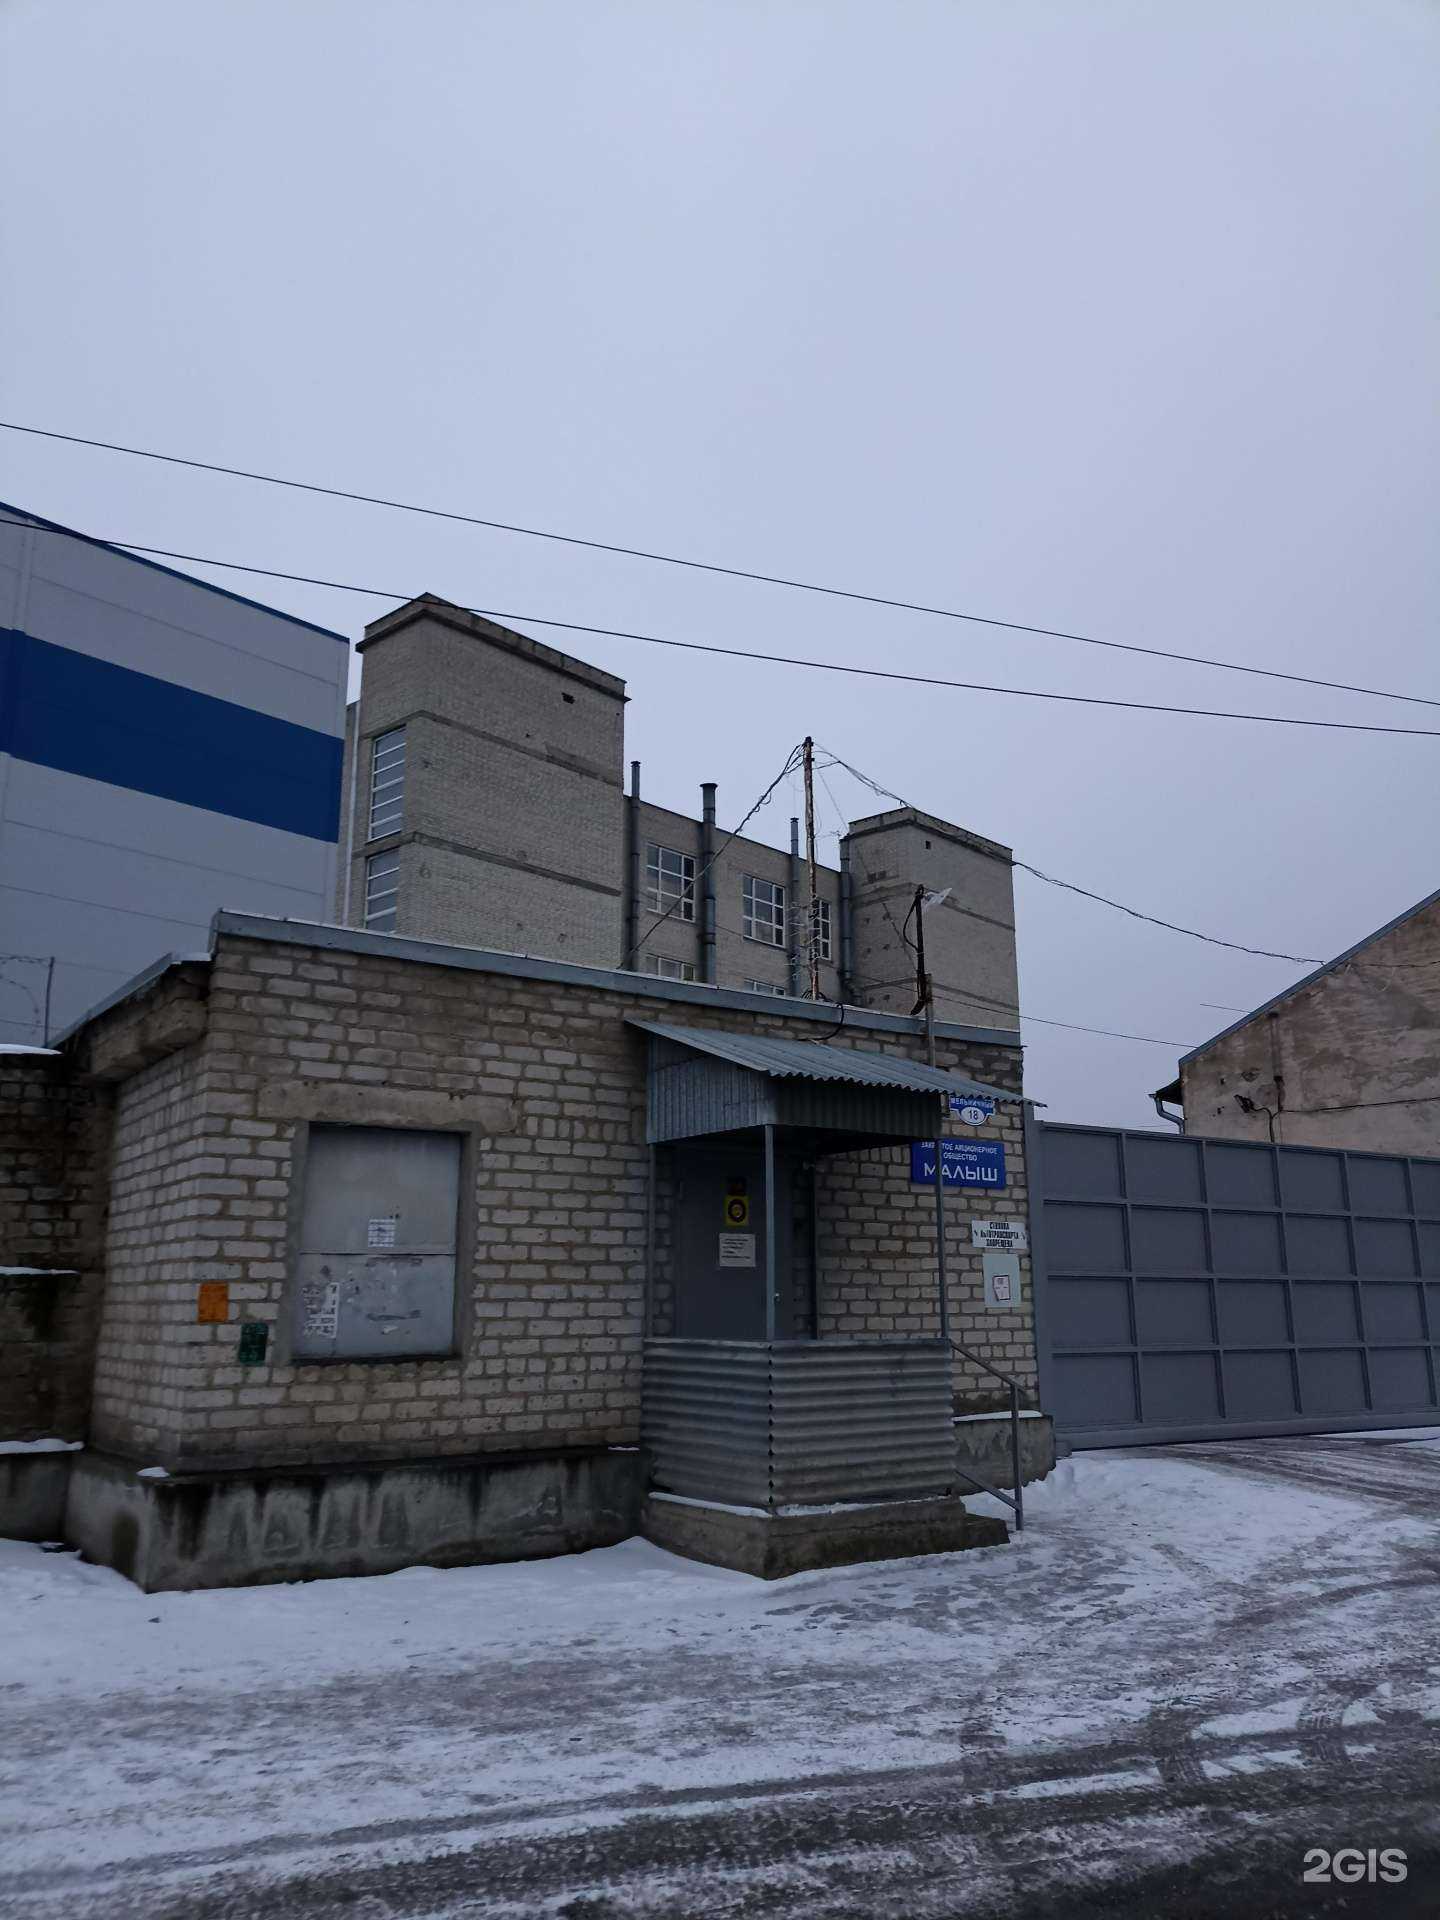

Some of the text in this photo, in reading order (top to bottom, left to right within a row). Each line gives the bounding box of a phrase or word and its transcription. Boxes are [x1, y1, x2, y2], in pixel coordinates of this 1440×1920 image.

[968, 1110, 979, 1120] 18
[943, 1152, 977, 1161] ОБЩЕСТВО
[924, 1162, 997, 1181] МАЛЫШ
